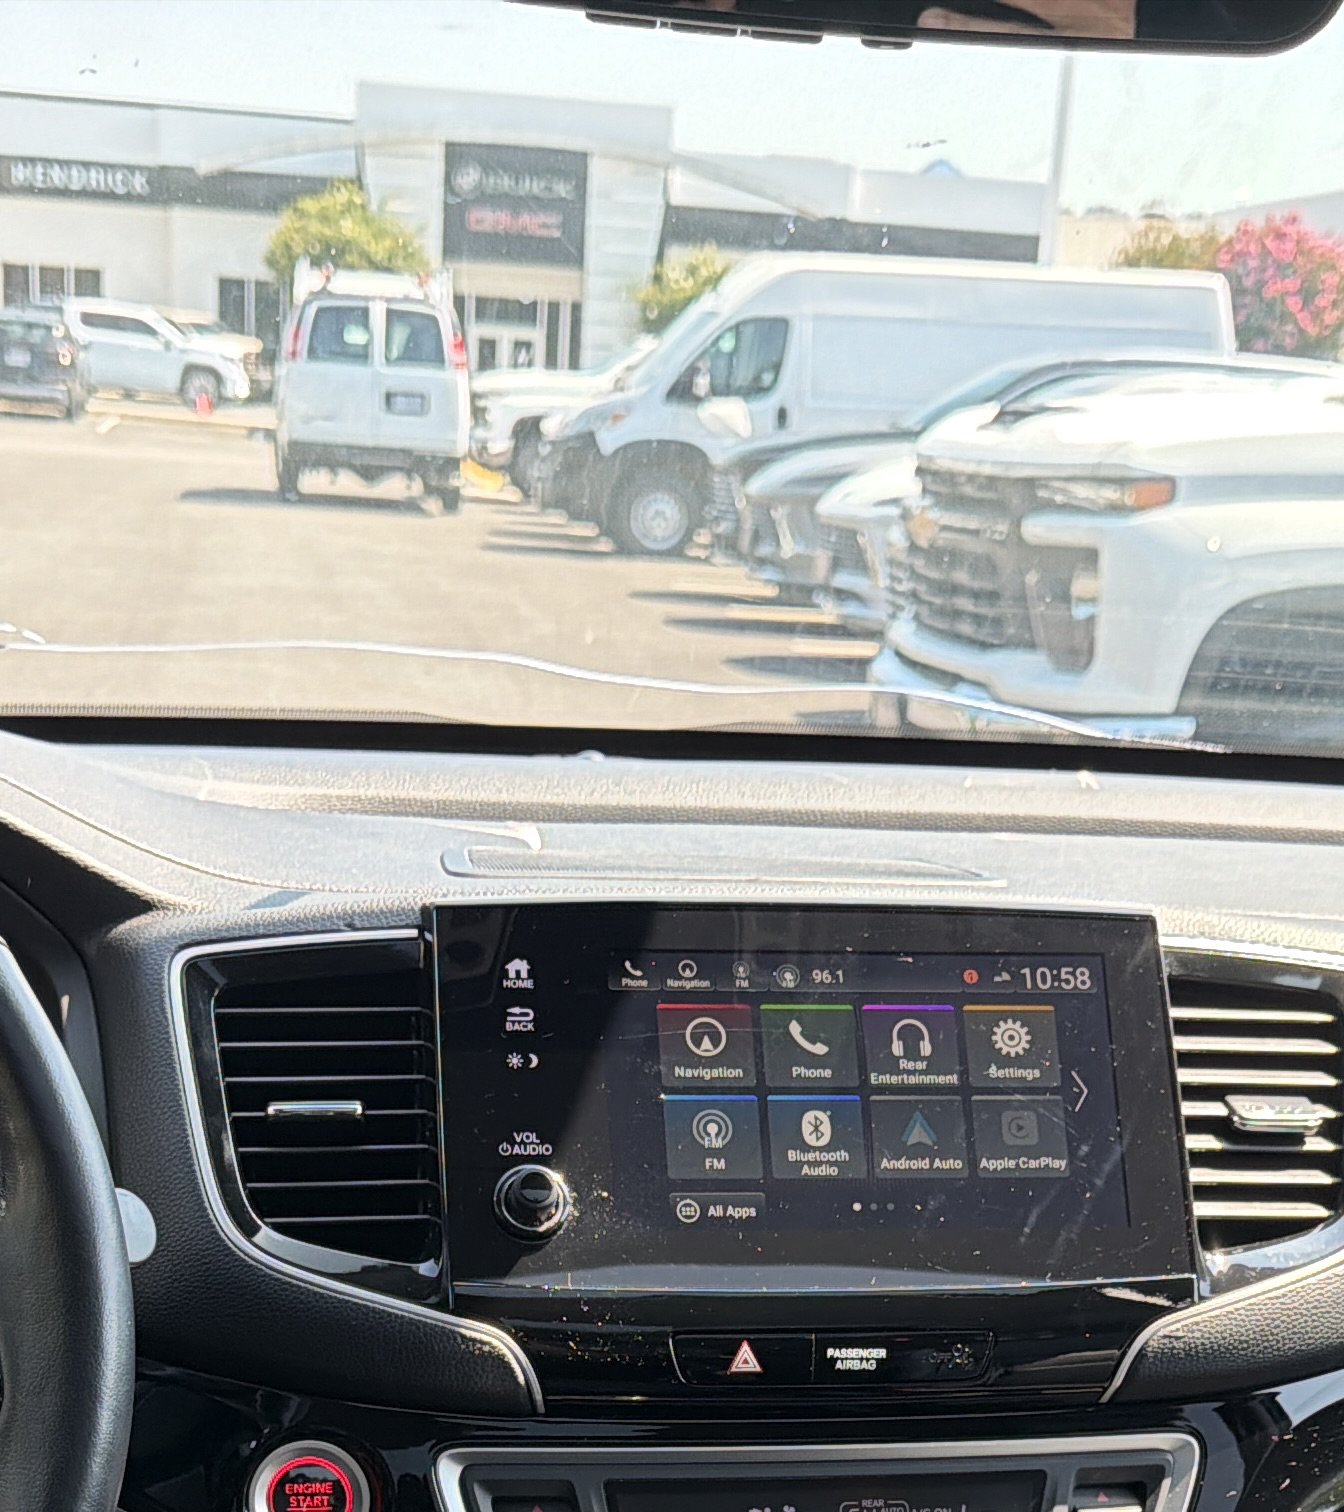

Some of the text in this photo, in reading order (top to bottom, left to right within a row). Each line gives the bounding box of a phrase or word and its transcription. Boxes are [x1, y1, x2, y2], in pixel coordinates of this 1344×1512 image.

[11, 159, 150, 196] HENDRICK
[622, 978, 648, 987] Phone
[812, 970, 844, 983] 96.1
[1020, 967, 1092, 991] 10:58
[502, 979, 534, 989] HOME
[667, 979, 710, 988] Navigation
[735, 979, 749, 988] FM
[505, 1022, 535, 1031] BACK
[899, 1059, 928, 1070] Rear
[674, 1066, 744, 1081] Navigation
[792, 1067, 832, 1078] Phone
[988, 1067, 1041, 1080] Settings
[870, 1073, 959, 1085] Entertainment
[513, 1132, 540, 1142] VOL
[704, 1137, 723, 1149] FM
[513, 1144, 553, 1155] AUDIO
[787, 1149, 850, 1162] Bluetooth
[705, 1158, 725, 1170] FM
[880, 1157, 963, 1170] Android Auto
[979, 1157, 1067, 1171] Apple CarPlay
[801, 1164, 839, 1176] Audio
[707, 1205, 757, 1220] All Apps
[826, 1348, 887, 1359] PASSENGER
[835, 1360, 876, 1370] AIRBAG
[285, 1482, 333, 1494] ENGINE
[289, 1496, 329, 1507] START
[862, 1499, 884, 1508] REAR
